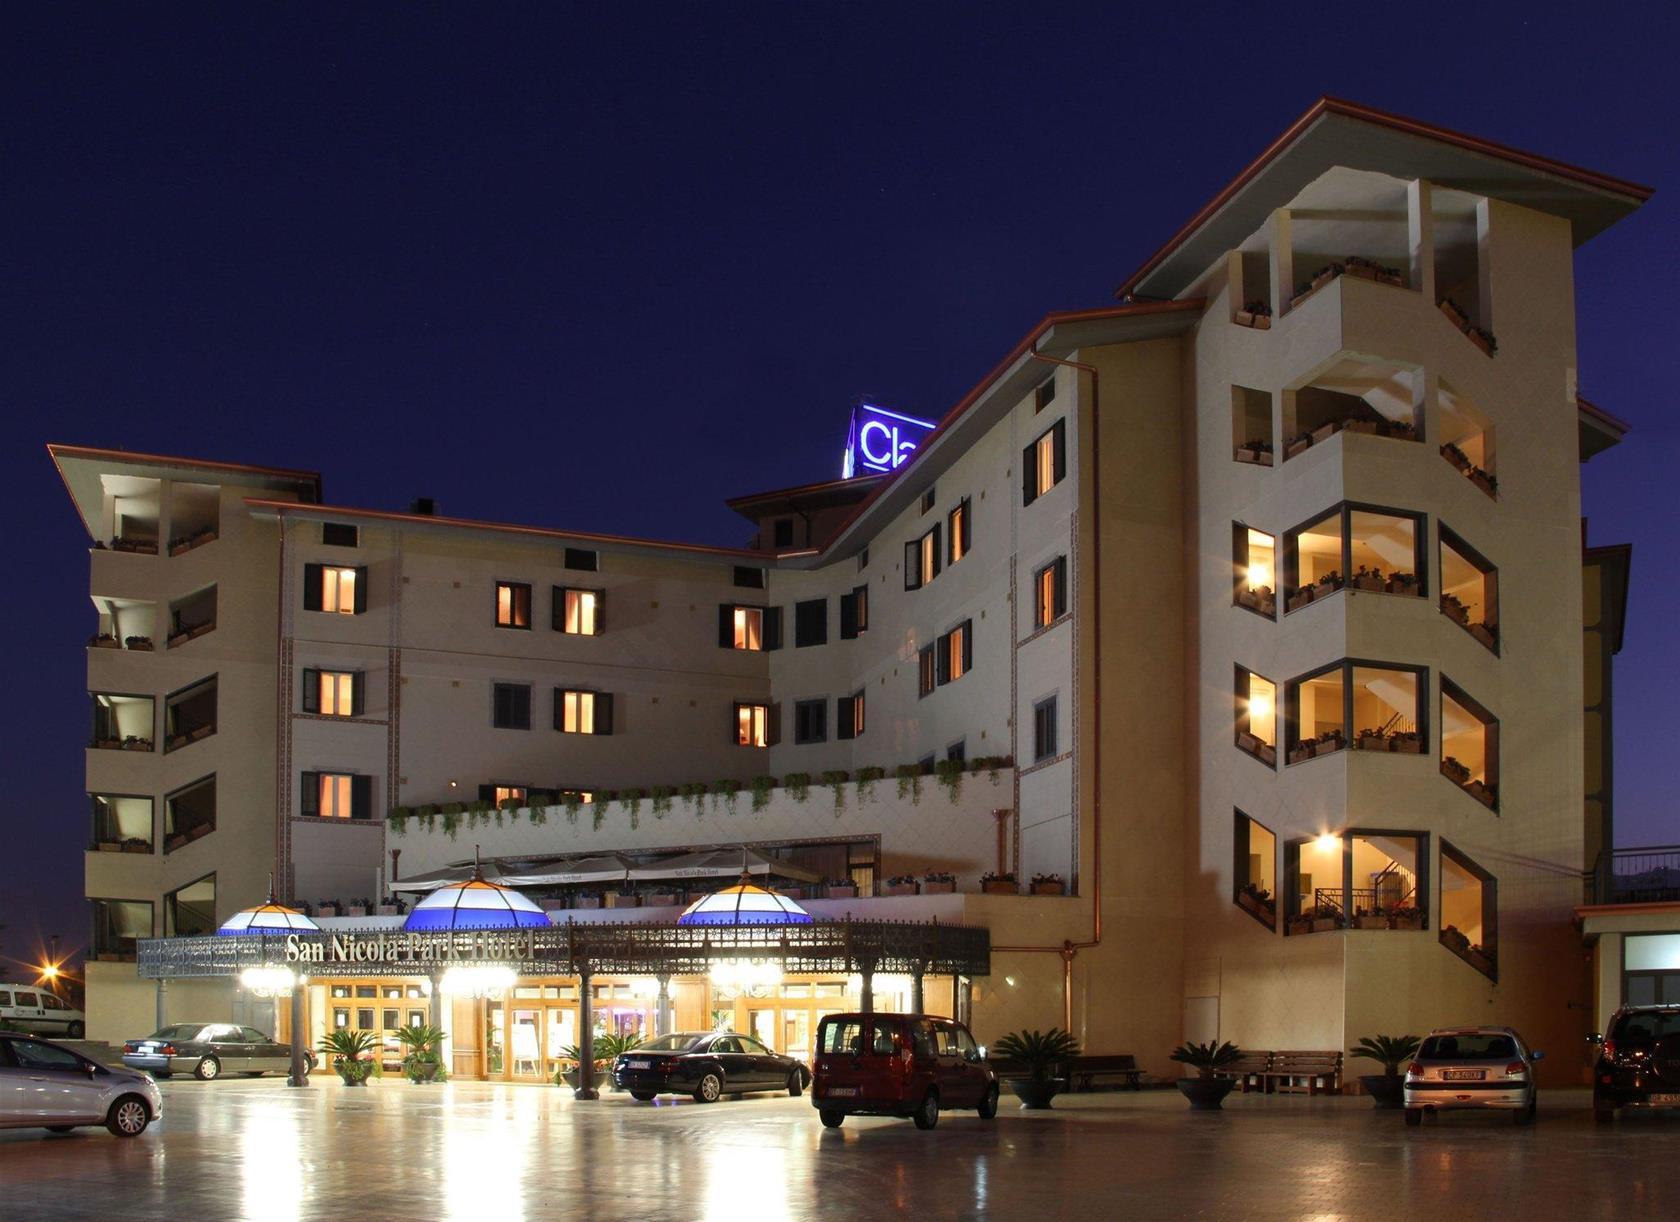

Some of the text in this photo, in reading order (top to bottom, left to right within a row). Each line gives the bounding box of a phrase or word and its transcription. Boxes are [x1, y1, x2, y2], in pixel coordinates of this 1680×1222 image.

[286, 930, 535, 962] San Nicola Park Hotel
